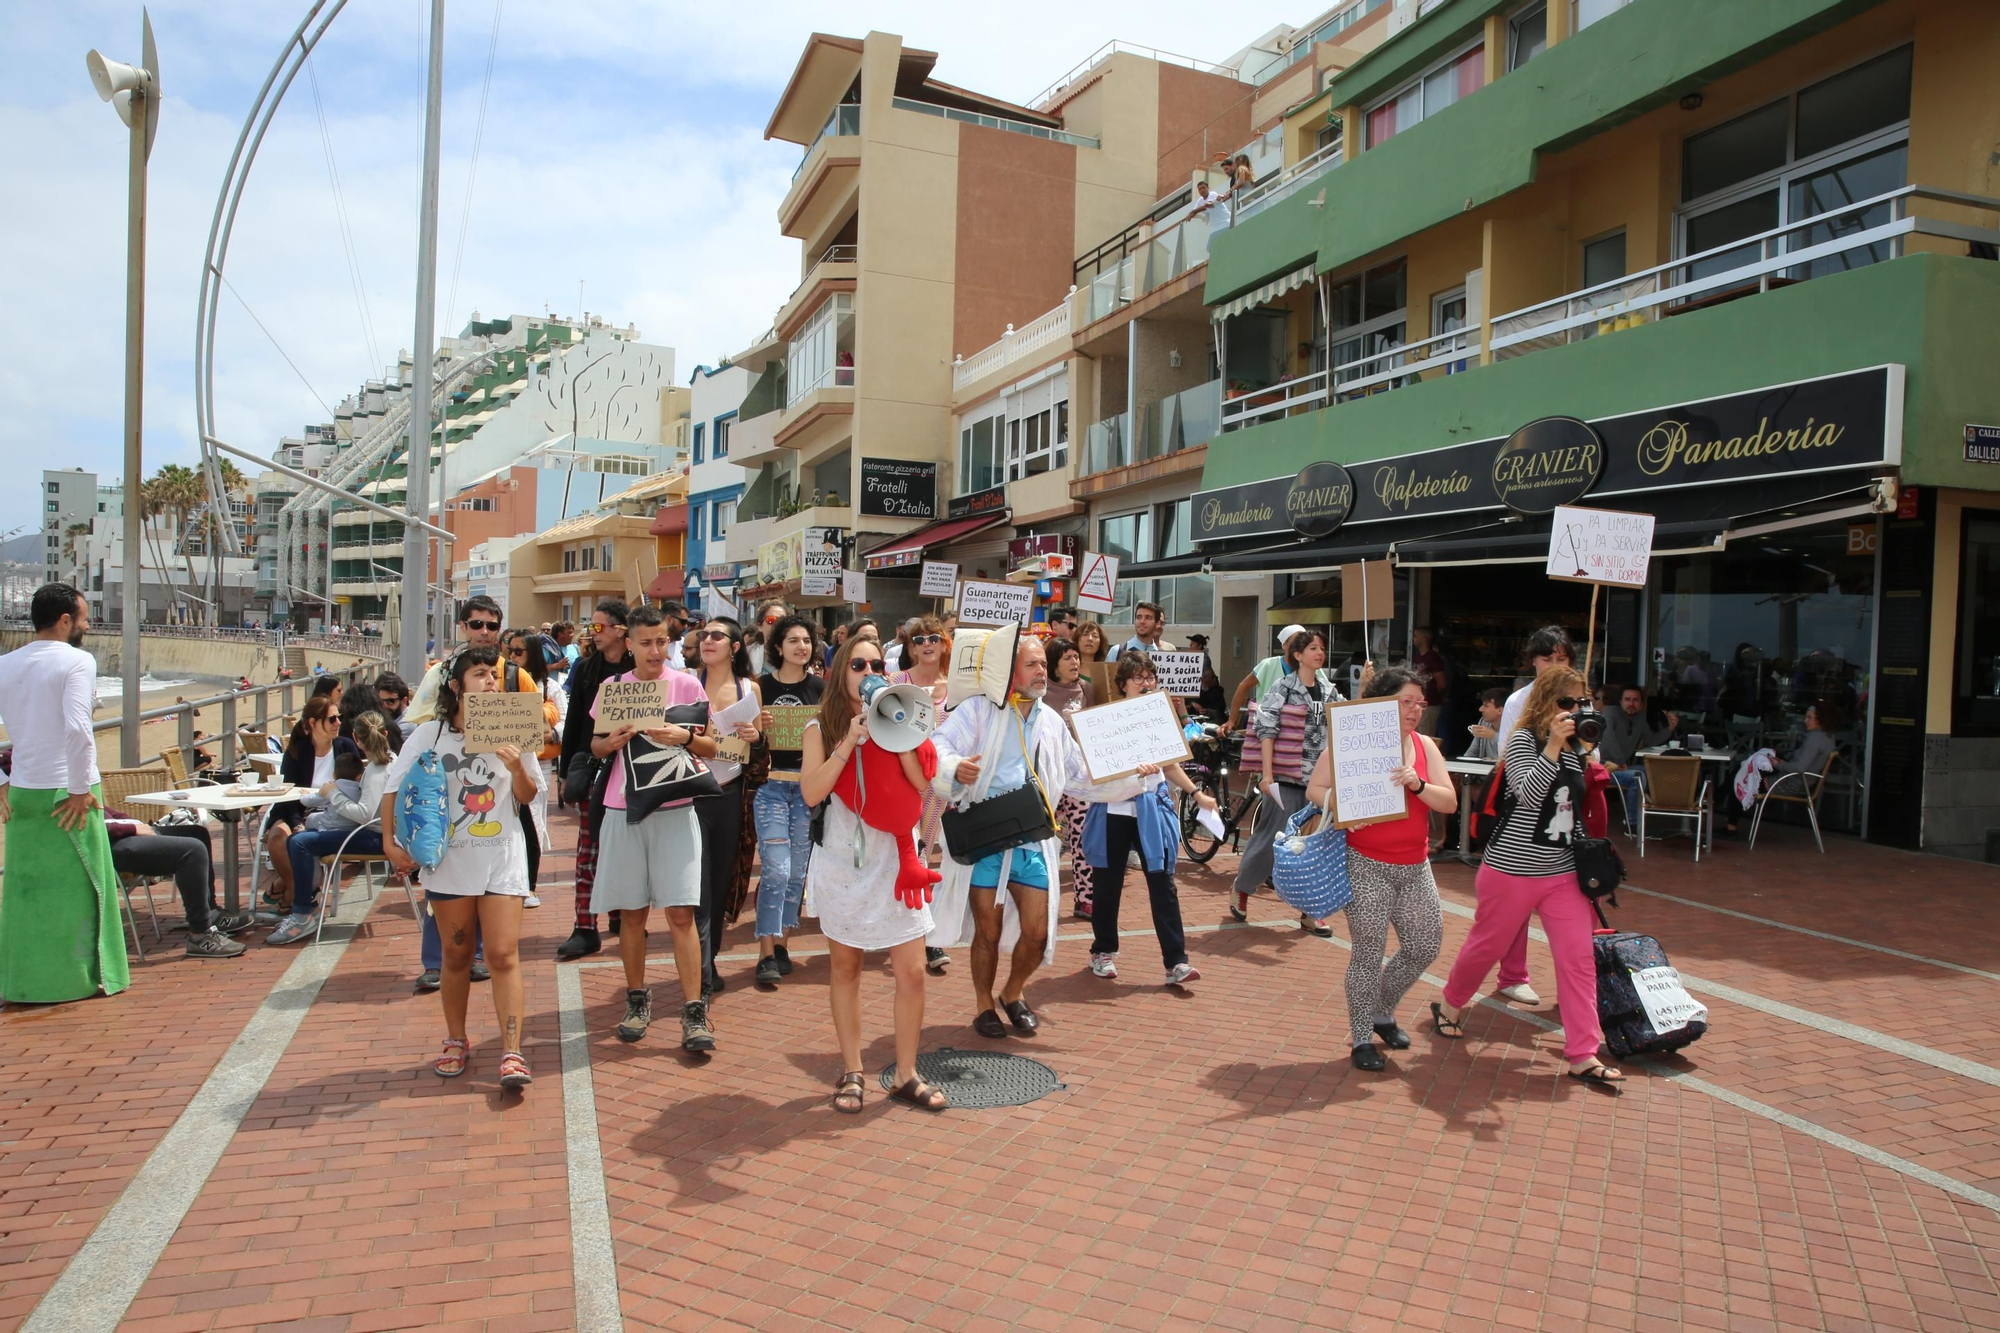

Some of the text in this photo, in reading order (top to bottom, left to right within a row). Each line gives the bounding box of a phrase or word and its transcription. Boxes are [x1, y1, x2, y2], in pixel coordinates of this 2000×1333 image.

[1979, 429, 2000, 438] CALLE
[1638, 417, 1845, 475] Panadería
[1969, 446, 2000, 460] GALILEO
[863, 463, 935, 477] ristorante pizzeria grill
[1495, 444, 1597, 484] GRANIER
[867, 477, 908, 494] Fratelli
[1374, 465, 1473, 512] Cafetería
[1534, 474, 1584, 490] artesanos
[1288, 484, 1350, 513] GRANIER
[1201, 498, 1274, 531] Panadería
[1589, 515, 1646, 534] PA LIMPIAR
[1595, 534, 1606, 548] PA
[1612, 535, 1648, 553] SERVIR
[805, 557, 839, 565] PIZZAS
[1584, 554, 1626, 568] Y SIN SITIO
[1605, 569, 1645, 582] PA DORMIR
[966, 587, 1029, 601] Guanarteme
[995, 601, 1009, 609] NO
[964, 607, 1026, 621] especular
[1180, 655, 1199, 663] HACE
[1157, 665, 1200, 674] IDA SOCIAL
[605, 681, 656, 697] BARRIO
[511, 697, 522, 707] EL
[620, 696, 661, 704] PELIGRO
[610, 704, 665, 720] EXTINCIÓN
[1087, 699, 1166, 727] EN LA ISLETA
[1102, 717, 1168, 739] GUANARTEME
[1340, 713, 1366, 731] BYE
[1372, 710, 1396, 728] BYE
[473, 734, 521, 746] EL ALQUILER
[1094, 733, 1161, 758] ALQUILAR YA
[1105, 742, 1184, 773] NO SE PUEDE
[1339, 759, 1371, 778] ESTE
[1339, 781, 1387, 803] ES PARA
[1350, 796, 1396, 817] VIVIR
[472, 837, 511, 847] MOUSE
[1640, 972, 1655, 981] UN
[1646, 982, 1671, 992] PARA
[1655, 1006, 1672, 1016] LAS
[1658, 1019, 1672, 1029] NO
